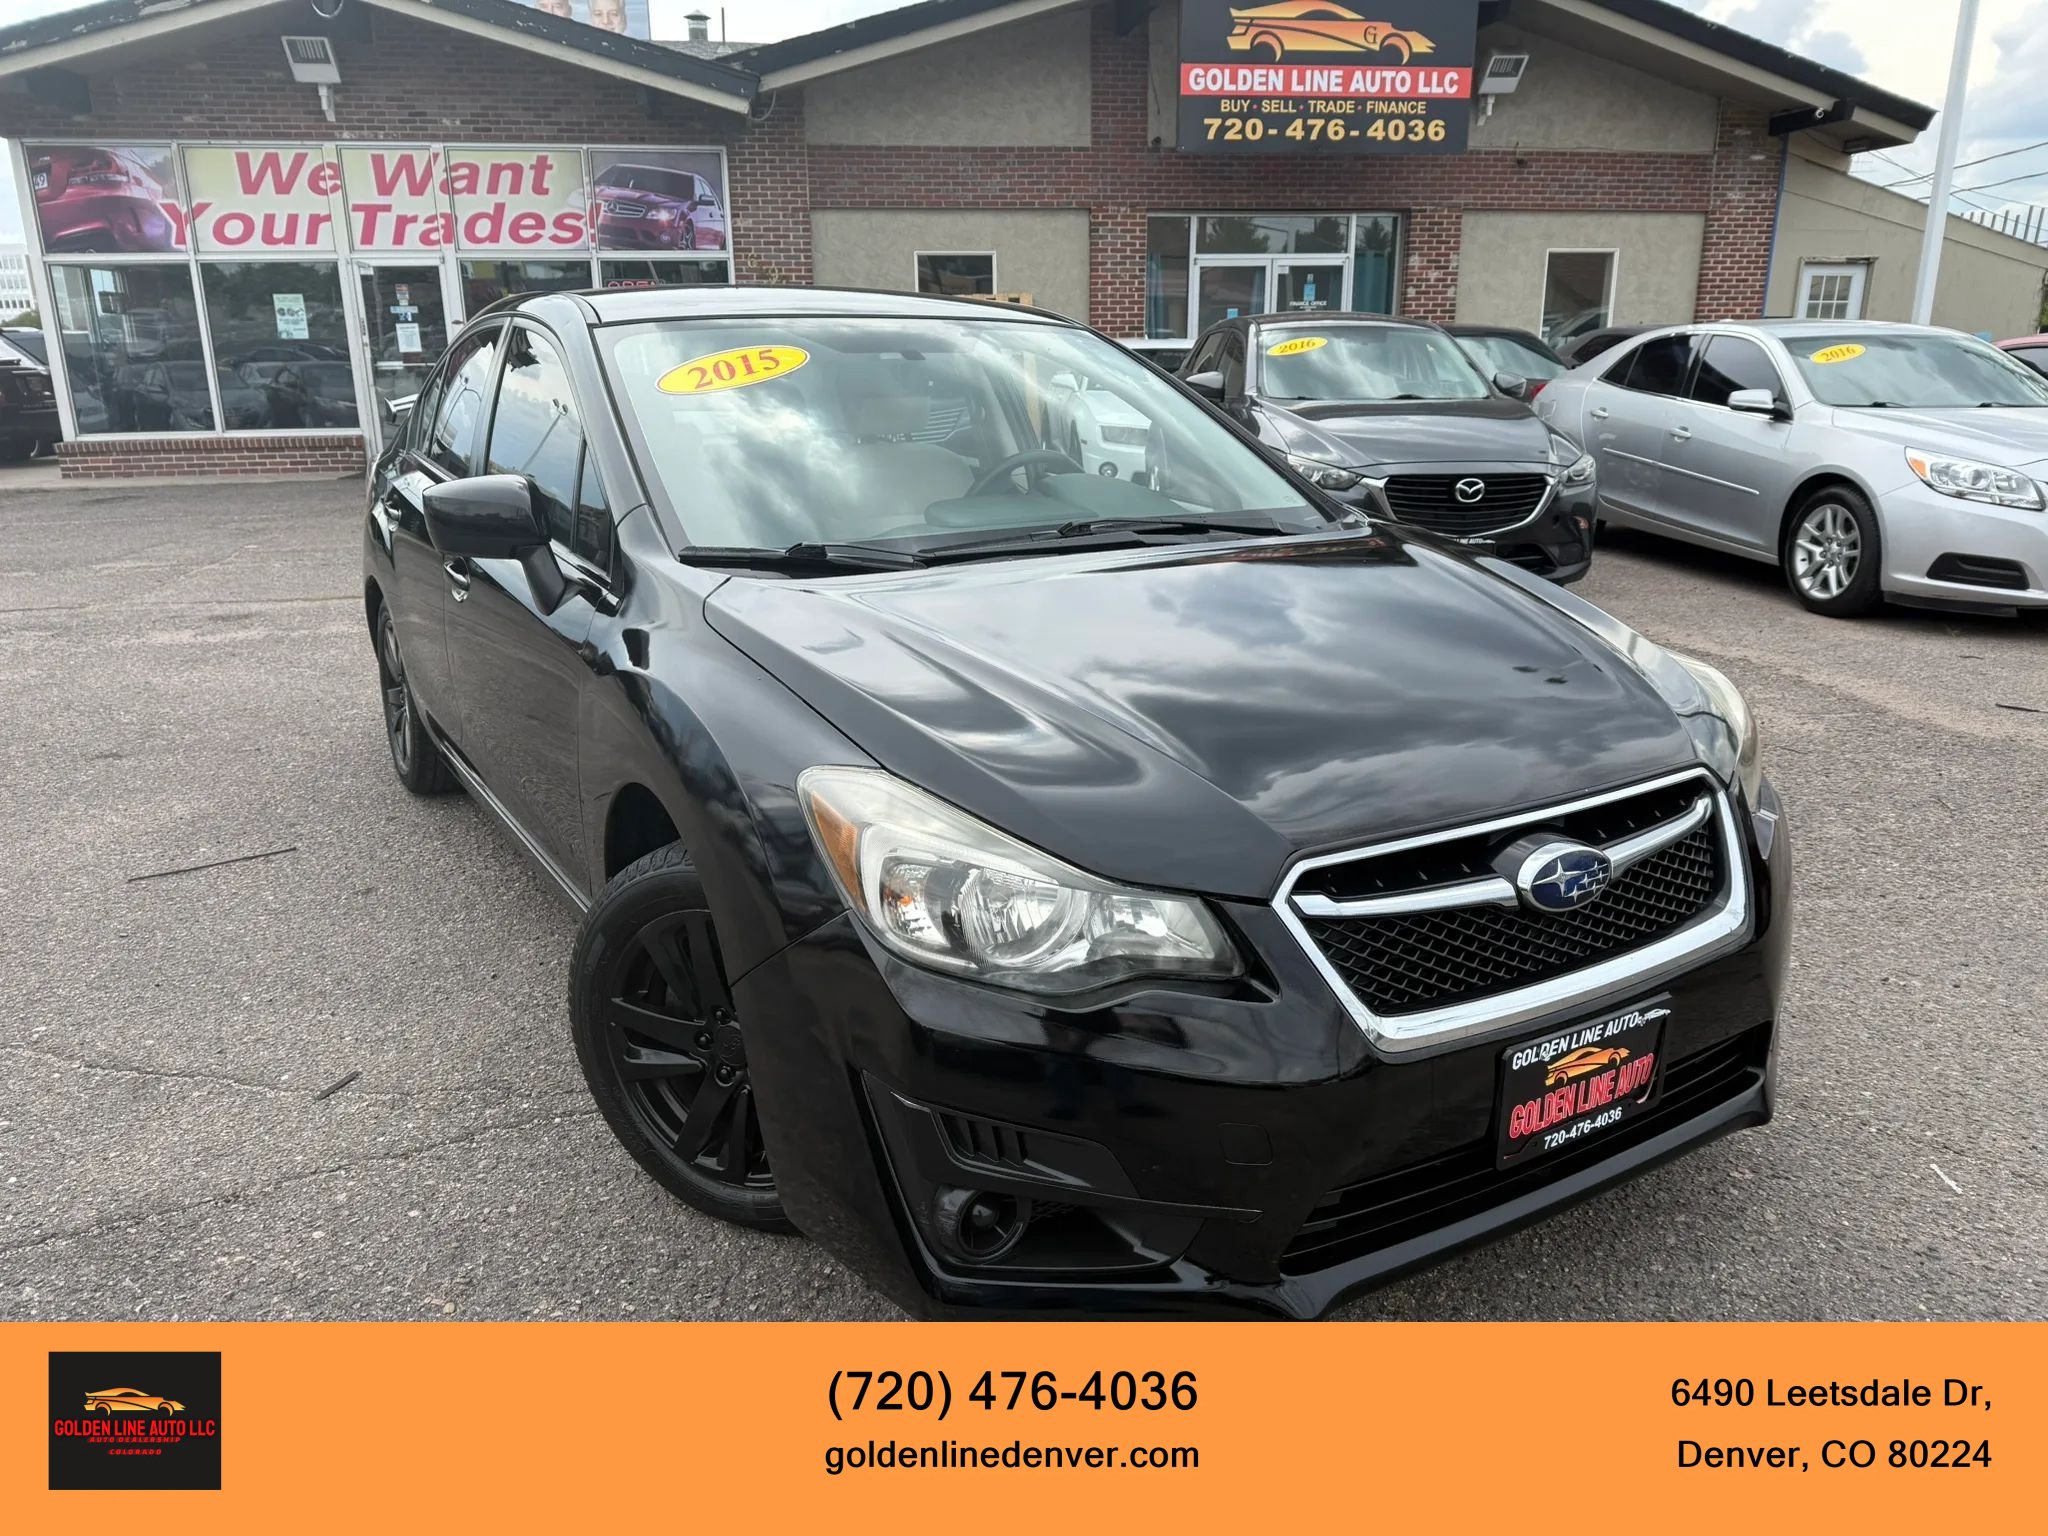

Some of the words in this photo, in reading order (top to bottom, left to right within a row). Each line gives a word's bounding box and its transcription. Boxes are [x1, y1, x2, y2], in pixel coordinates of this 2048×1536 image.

[1188, 68, 1283, 92] GOLDEN
[1291, 69, 1344, 93] LINE
[1349, 70, 1411, 94] AUTO
[1417, 71, 1460, 95] LLC
[1220, 99, 1250, 113] BUY
[1261, 100, 1297, 113] SELL
[1308, 100, 1355, 114] TRADE
[1366, 101, 1427, 115] FINANCE
[234, 151, 343, 196] We
[370, 152, 554, 197] Want
[159, 202, 333, 246] Your
[351, 200, 603, 247] Trades!
[1280, 339, 1316, 353] 2016
[1821, 346, 1856, 362] 2016
[687, 349, 781, 389] 2015
[1512, 1034, 1570, 1070] GOLDEN
[1571, 1024, 1605, 1049] LINE
[1604, 1011, 1640, 1037] AUTO
[1509, 1083, 1578, 1139] GOLDEN
[1577, 1069, 1617, 1114] LINE
[1614, 1052, 1655, 1099] AUTO
[1543, 1106, 1623, 1150] 720-476-4036
